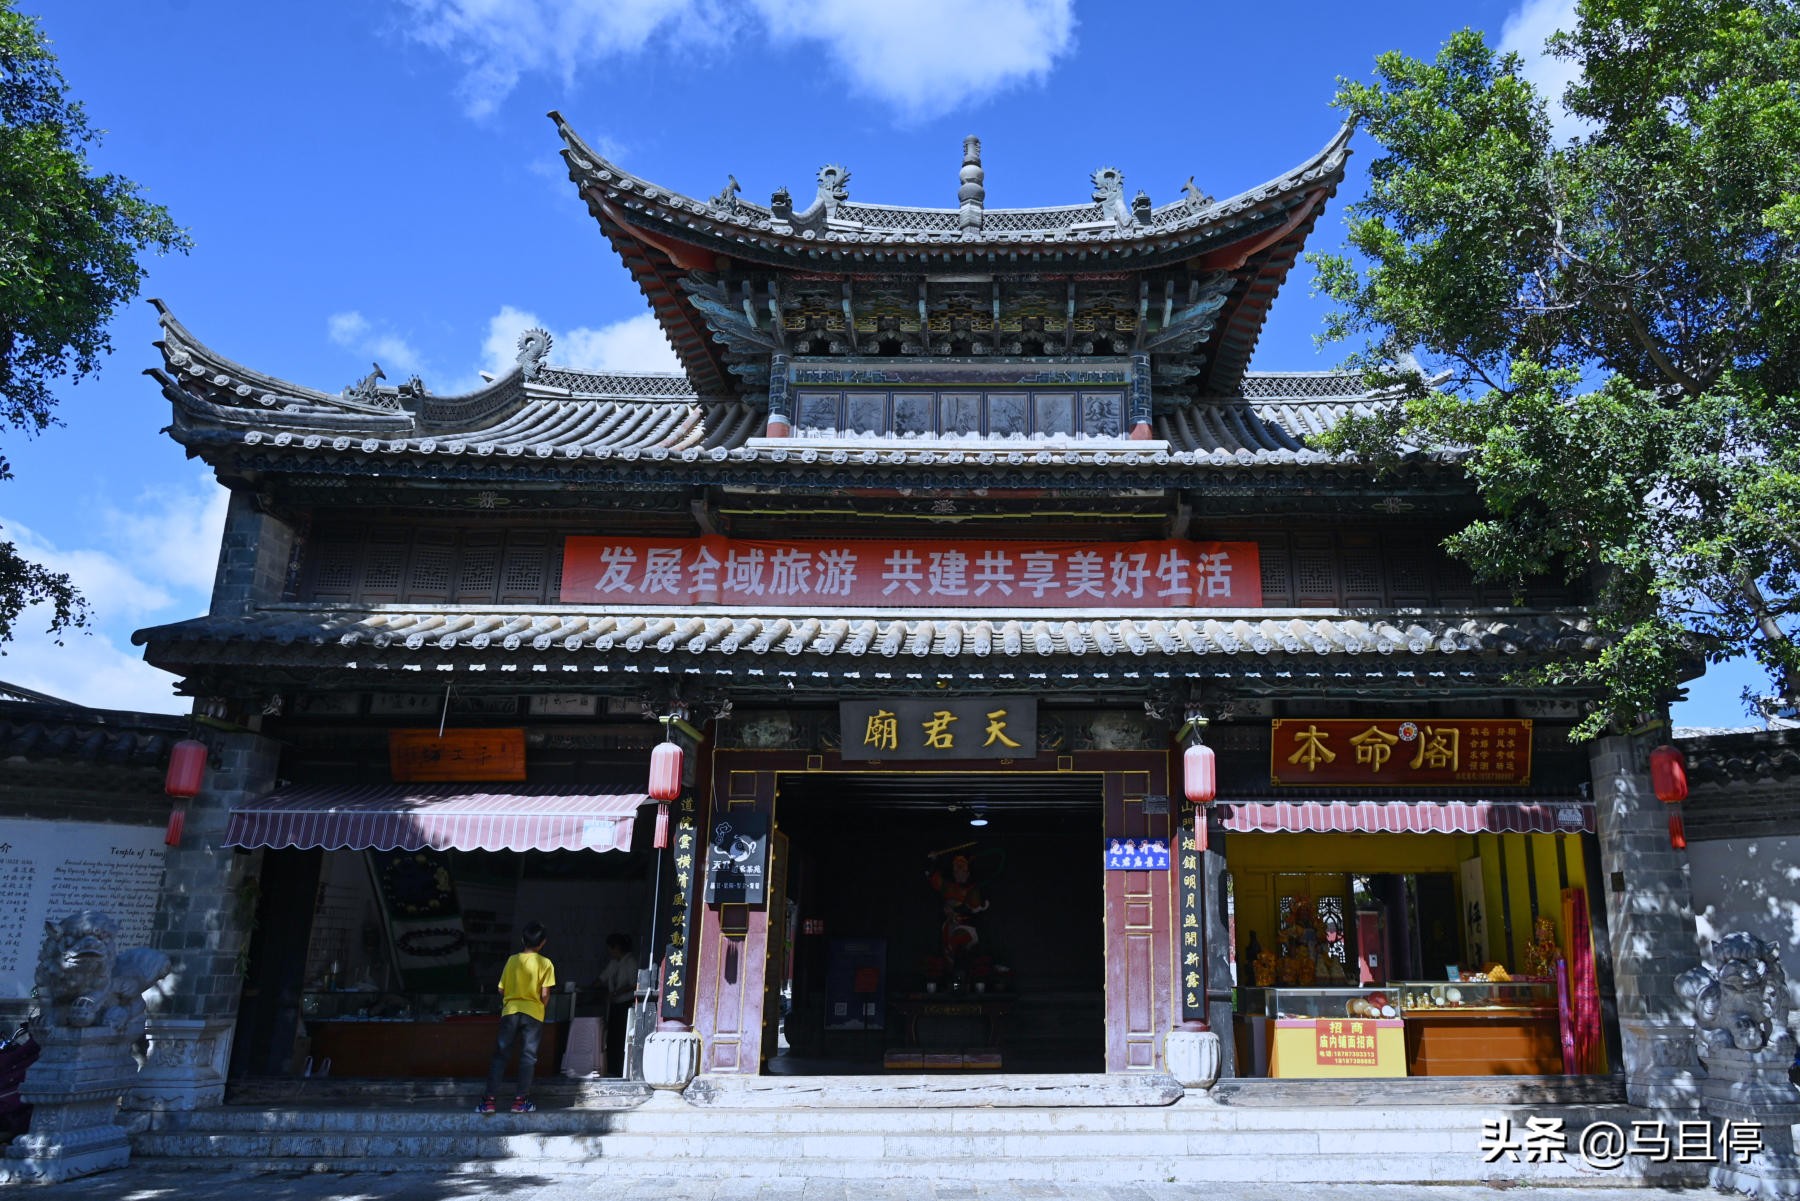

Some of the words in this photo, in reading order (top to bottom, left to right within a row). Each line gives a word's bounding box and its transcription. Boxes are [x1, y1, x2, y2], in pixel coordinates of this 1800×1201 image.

[594, 545, 858, 597] 发展全域旅游
[881, 548, 1233, 600] 共建共享美好生活
[1287, 724, 1460, 773] 本命阁
[110, 846, 135, 858] Temple
[1329, 1021, 1364, 1034] 招商
